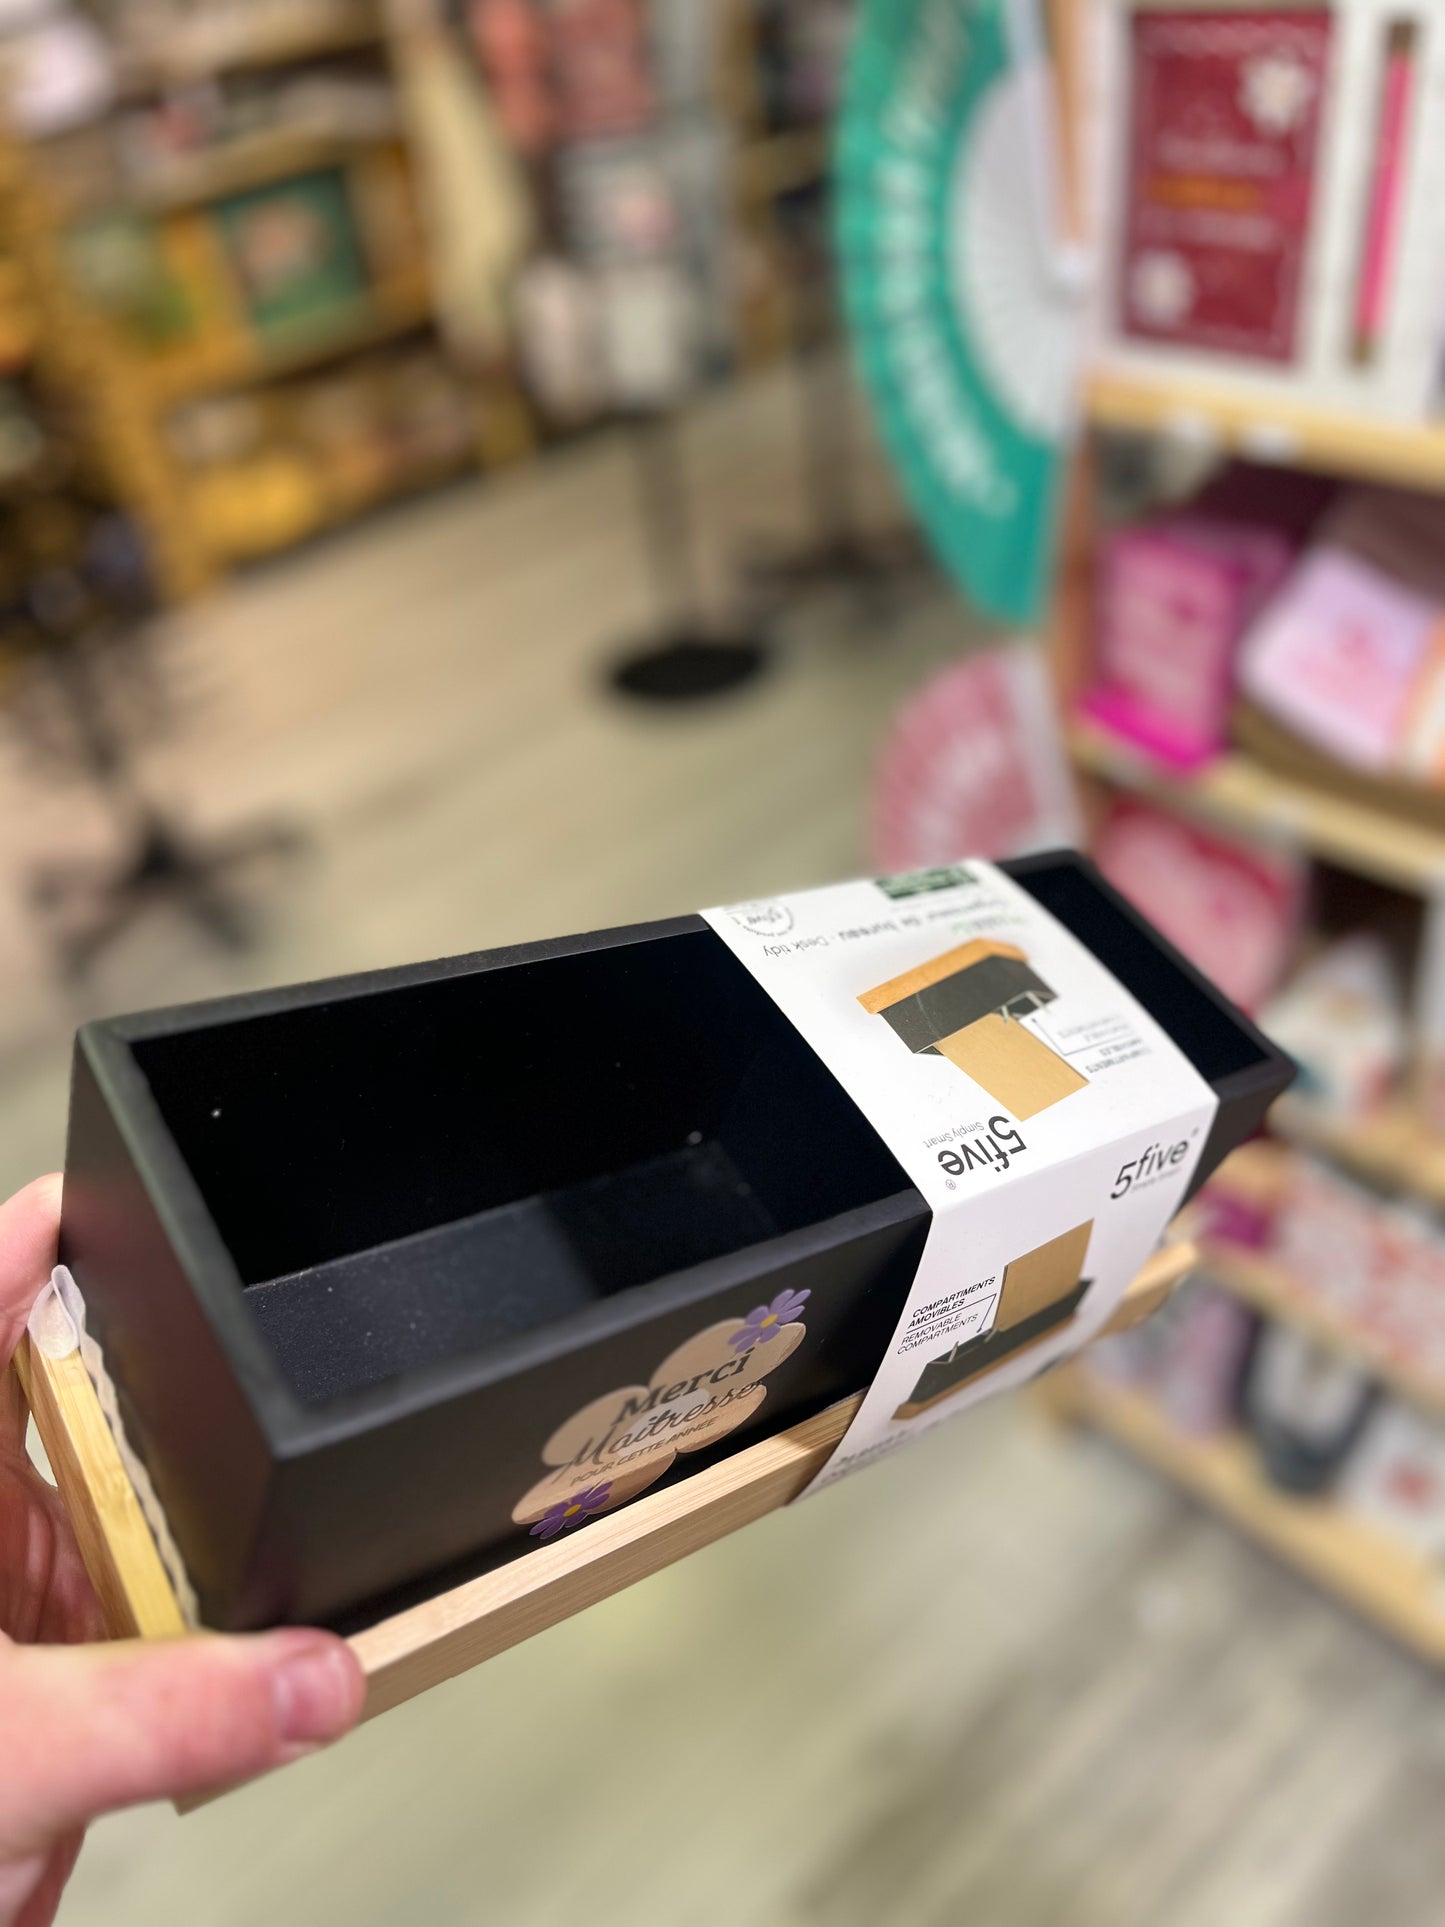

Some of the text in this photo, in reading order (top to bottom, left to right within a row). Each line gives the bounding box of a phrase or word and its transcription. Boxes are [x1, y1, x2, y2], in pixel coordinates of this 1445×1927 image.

[763, 944, 791, 957] tidy
[791, 936, 829, 951] Desk
[922, 1121, 985, 1149] Simply Smart
[938, 1115, 1027, 1176] 5five
[1110, 1140, 1189, 1200] 5five
[907, 1298, 966, 1329] AMOVIBLES
[912, 1276, 996, 1318] COMPARTIMENTS
[897, 1313, 979, 1355] COMPARTMENTS
[900, 1312, 962, 1345] REMOVABLE
[609, 1346, 757, 1428] Merci
[569, 1459, 615, 1487] POUR
[615, 1440, 664, 1468] CETTE
